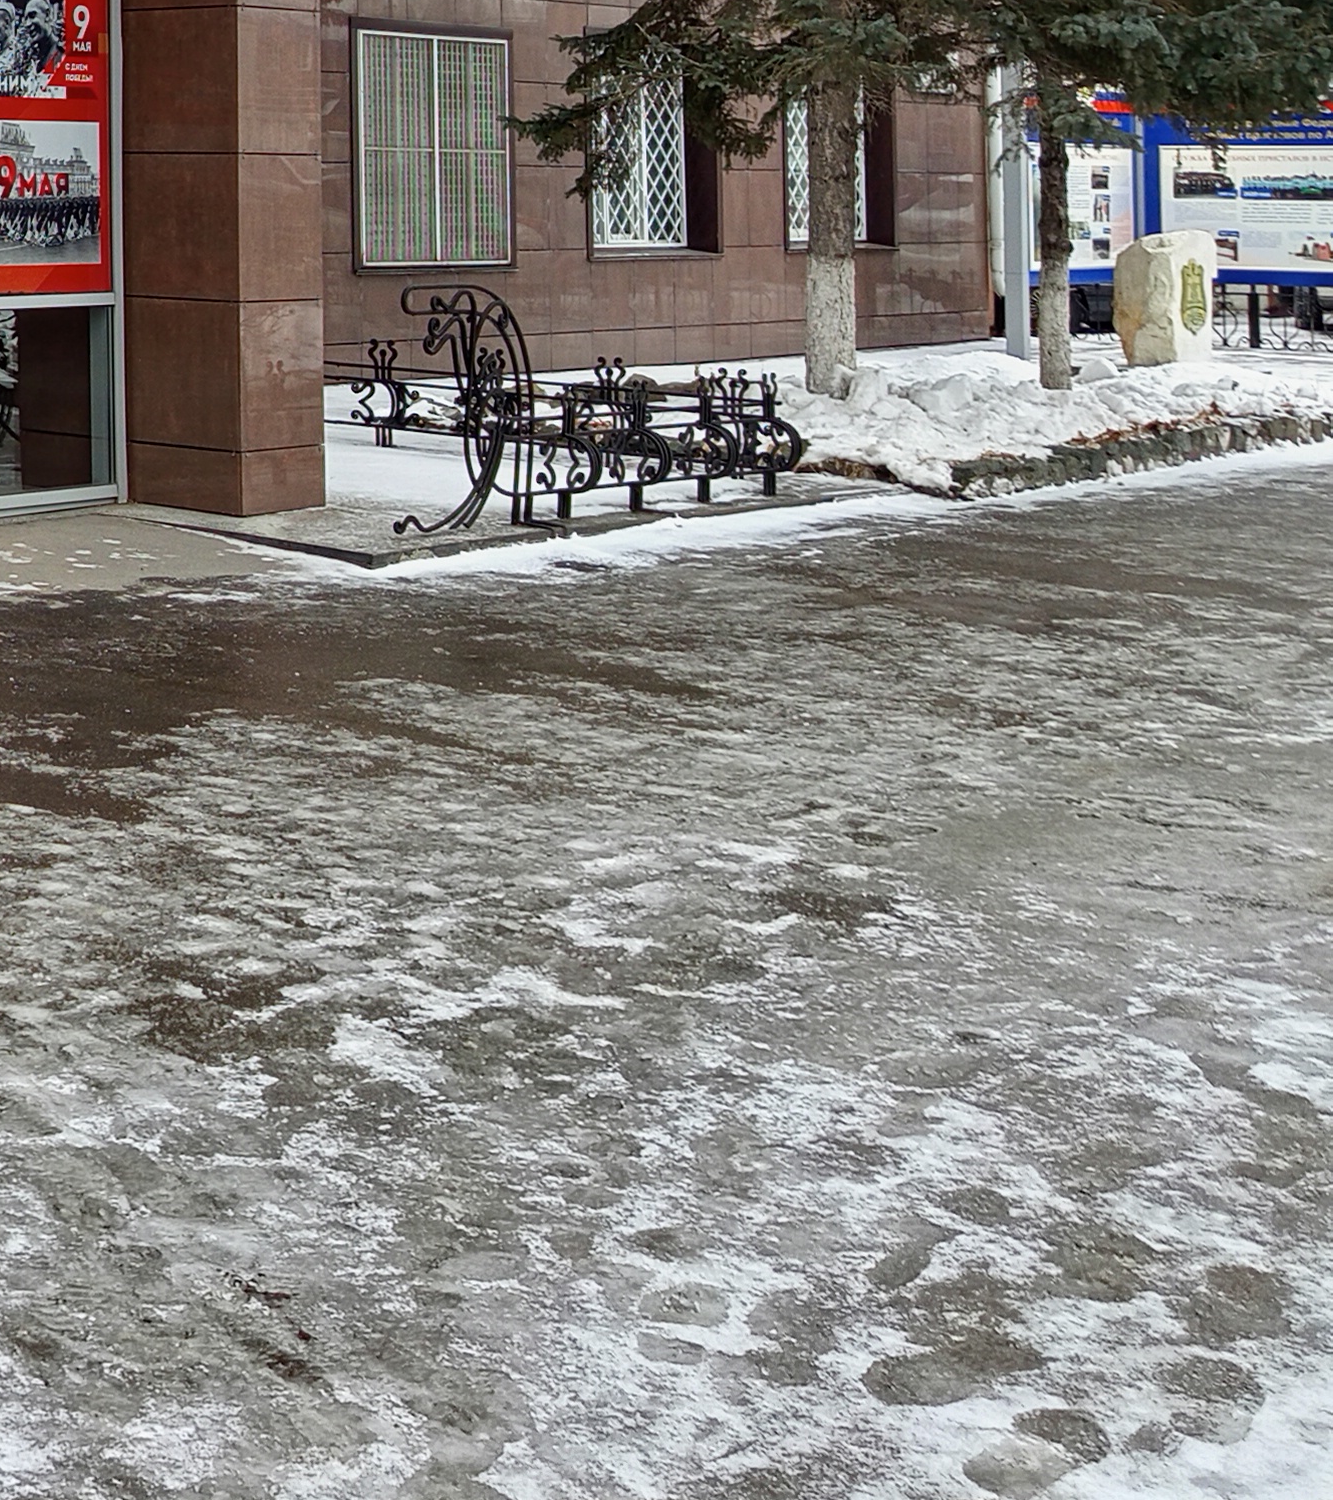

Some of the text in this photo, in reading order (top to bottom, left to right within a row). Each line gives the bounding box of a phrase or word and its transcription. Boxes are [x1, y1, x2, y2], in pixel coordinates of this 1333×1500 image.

[73, 5, 90, 39] 9
[72, 41, 92, 52] МАЯ
[17, 172, 69, 198] МАЯ
